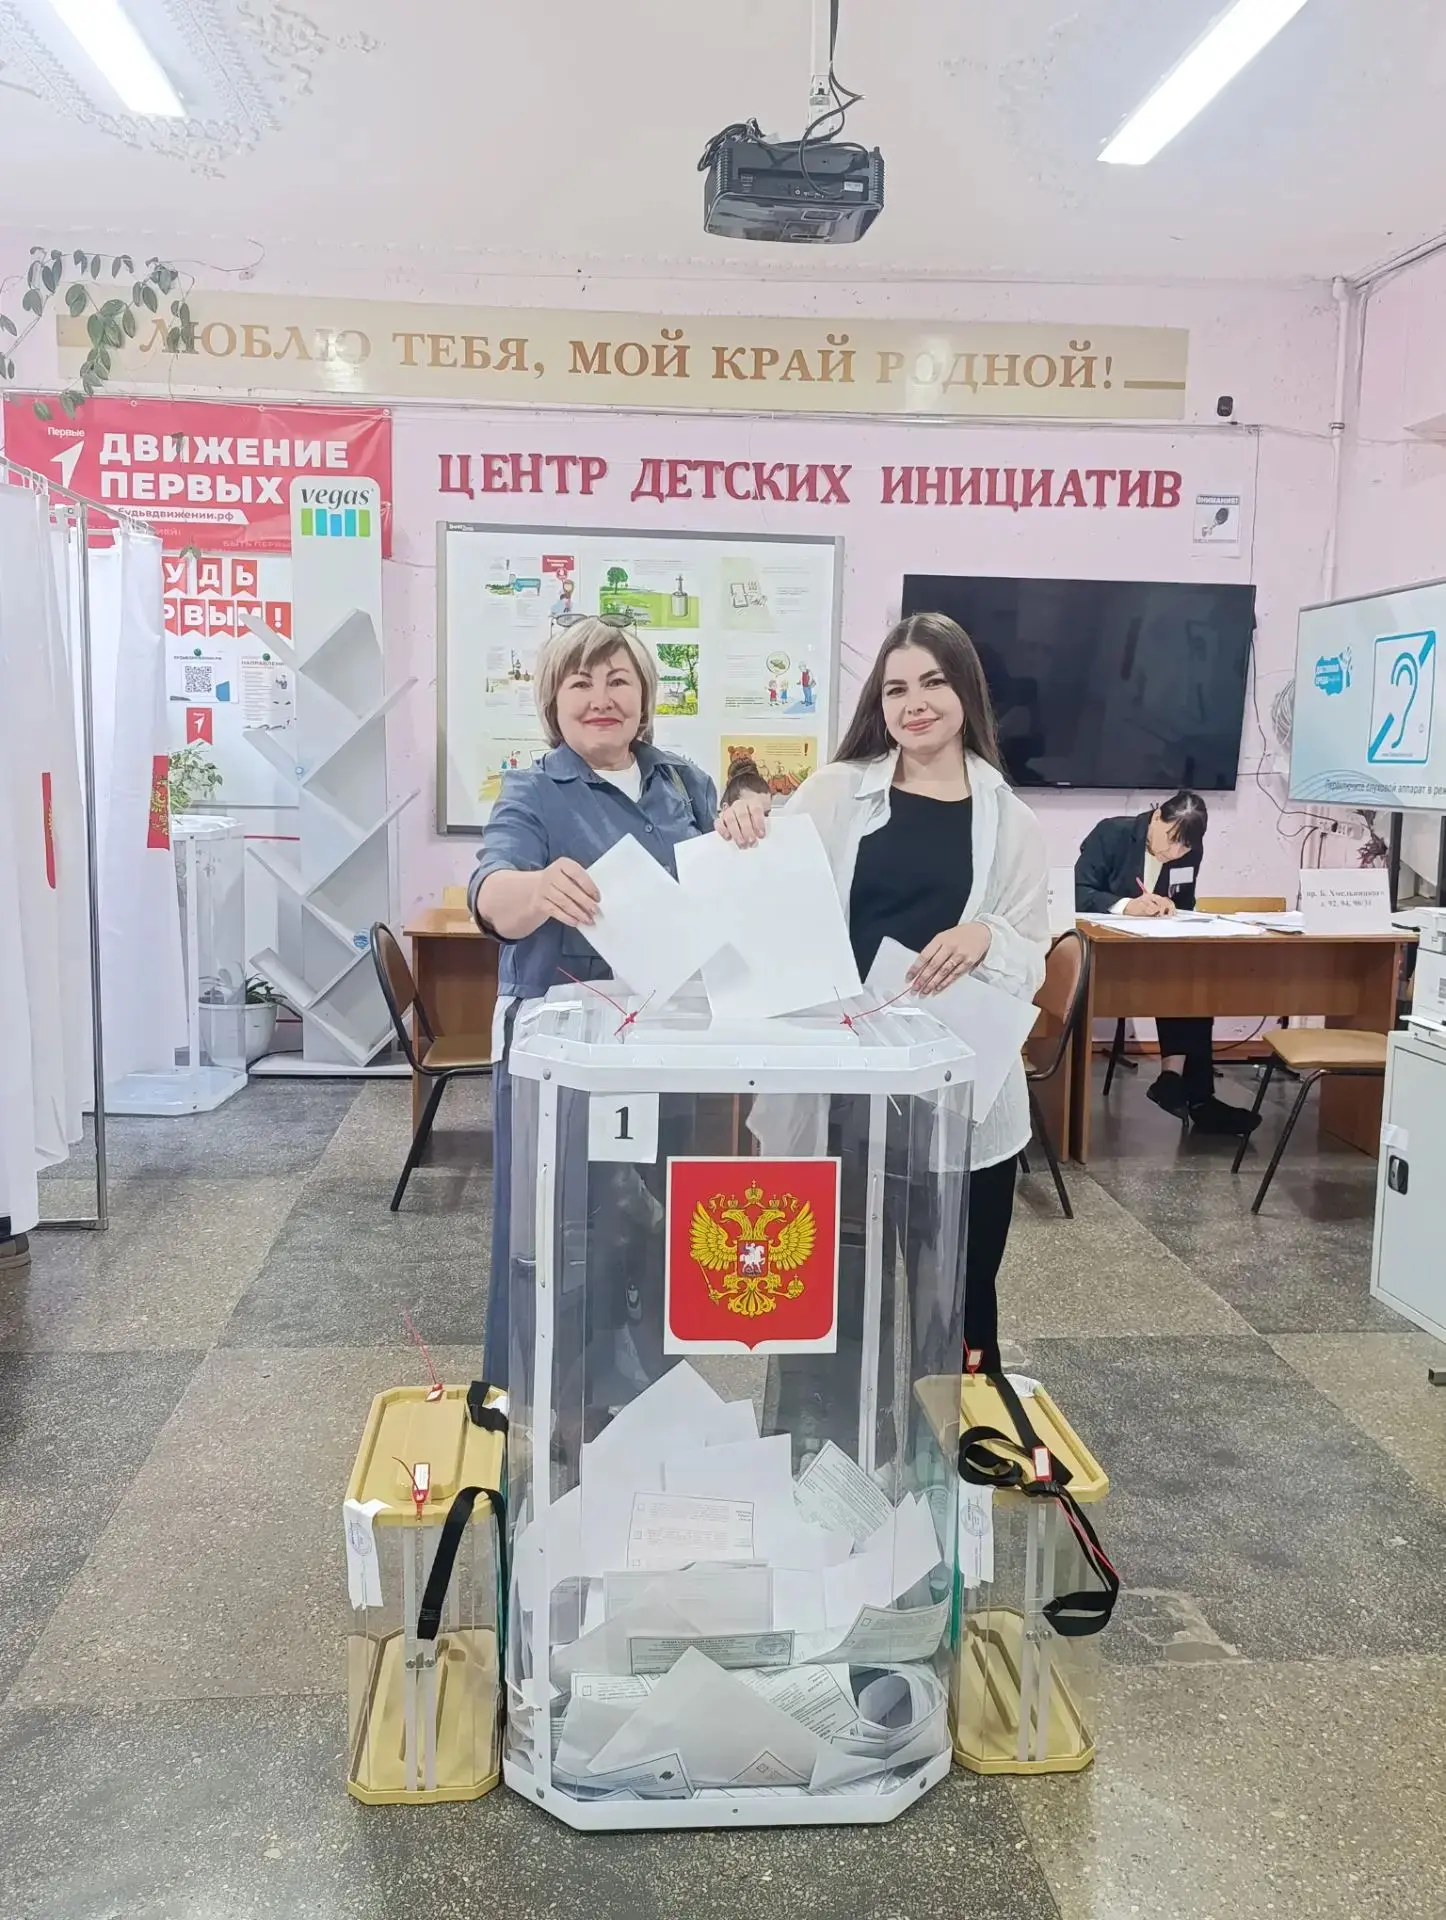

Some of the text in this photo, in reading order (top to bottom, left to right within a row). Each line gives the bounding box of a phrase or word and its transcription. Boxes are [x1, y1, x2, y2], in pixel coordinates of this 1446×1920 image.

[140, 318, 1113, 393] ЛЮБЛЮ ТЕБЯ, МОЙ КРАЙ РОДНОЙ!
[47, 426, 86, 439] Первые
[99, 432, 349, 468] ДВИЖЕНИЕ
[101, 471, 284, 504] ПЕРВЫХ
[301, 488, 370, 510] vegas
[438, 453, 1182, 512] ЦЕНТР ДЕТСКИХ ИНИЦИАТИВ
[614, 1106, 634, 1140] 1
